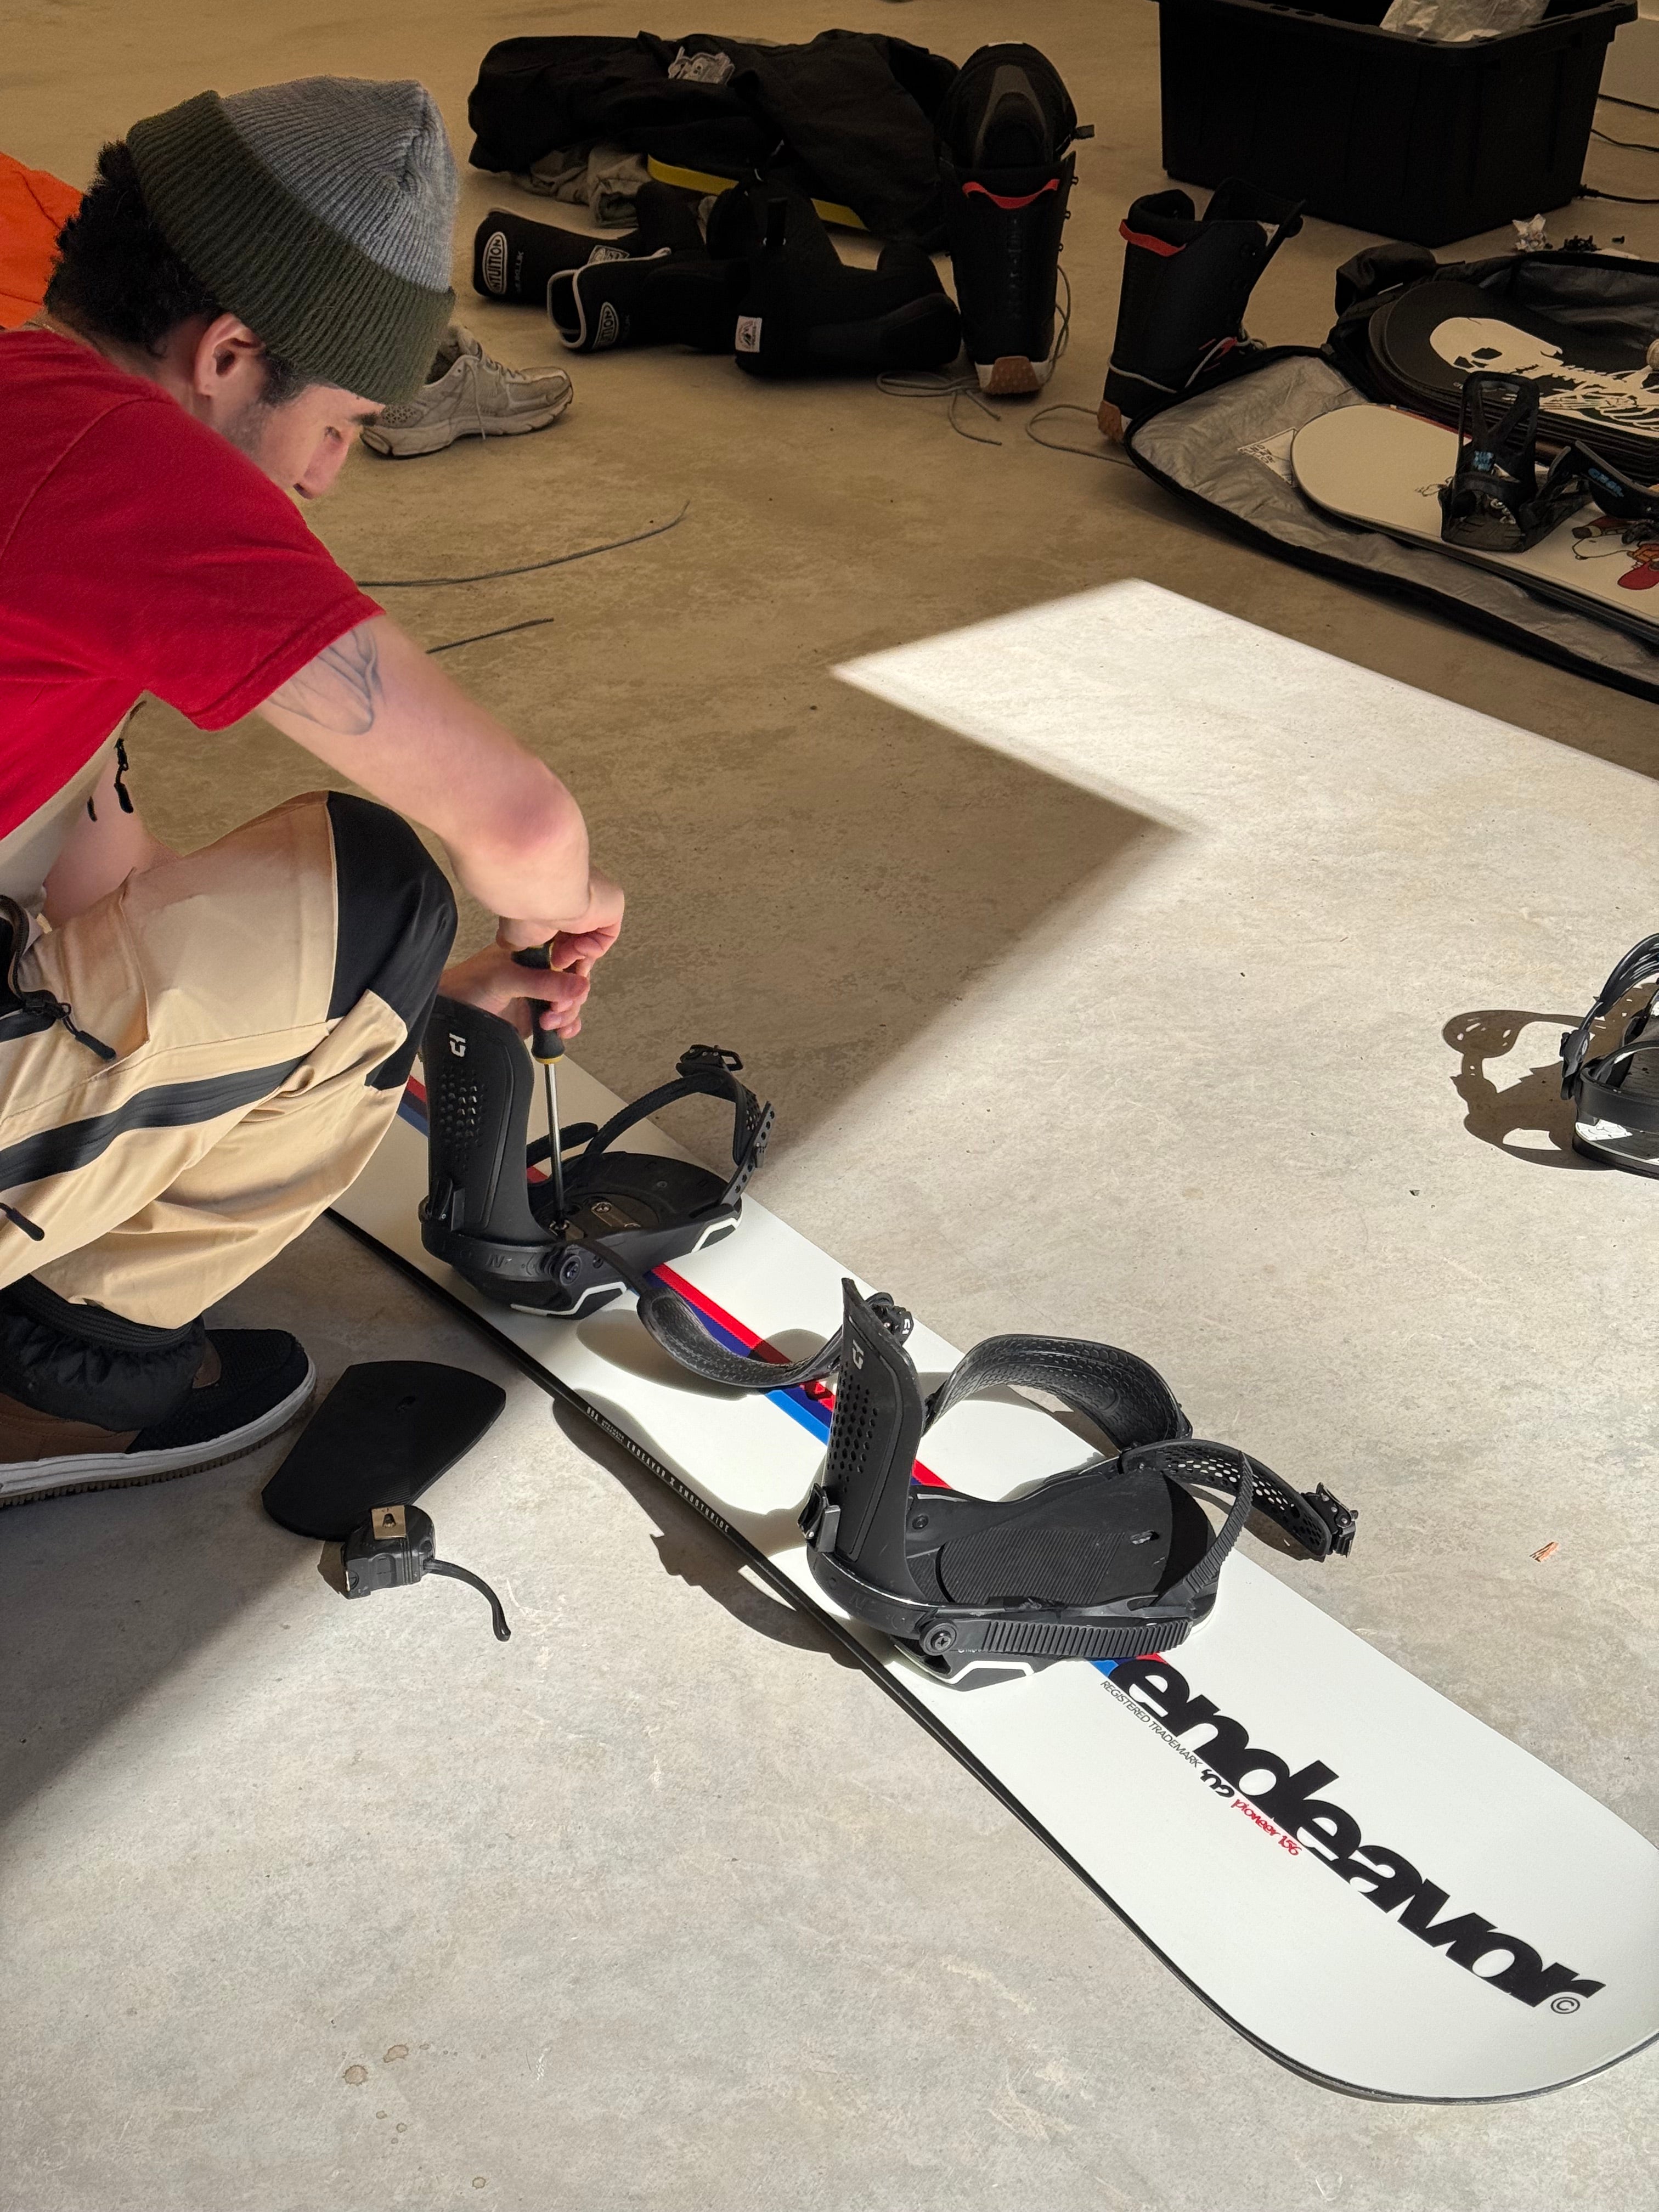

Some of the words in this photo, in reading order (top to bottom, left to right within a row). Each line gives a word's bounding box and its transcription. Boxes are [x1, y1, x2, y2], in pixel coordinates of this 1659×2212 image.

[627, 1440, 665, 1478] ENDEAVOR
[679, 1485, 729, 1533] SMOOTHRIDE
[1100, 1680, 1150, 1723] REGISTERED
[1148, 1720, 1203, 1769] TRADEMARK
[1231, 1799, 1280, 1836] pioneer
[1278, 1835, 1302, 1855] 156
[1108, 1660, 1606, 2007] endeavor
